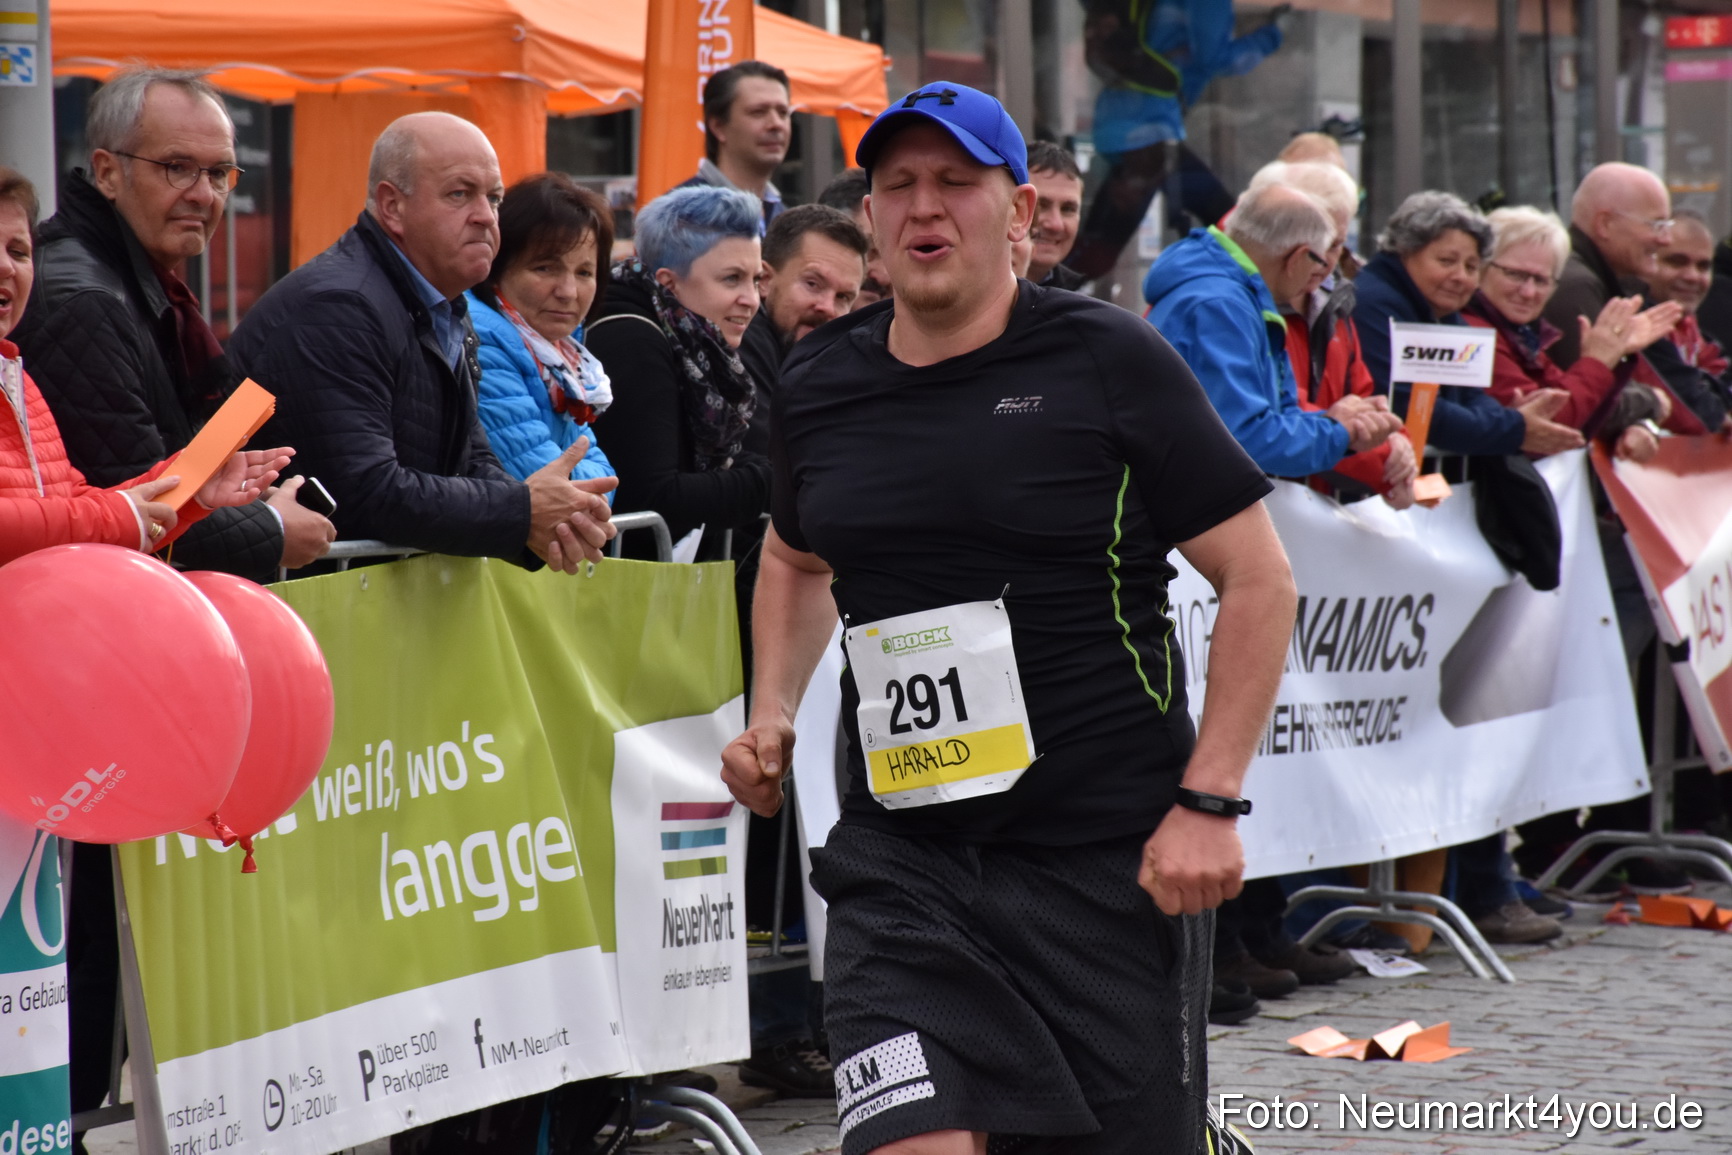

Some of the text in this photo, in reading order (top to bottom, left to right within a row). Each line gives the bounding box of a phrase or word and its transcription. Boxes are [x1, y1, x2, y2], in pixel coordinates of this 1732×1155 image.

[1402, 346, 1456, 362] swn
[892, 626, 952, 652] BOCK
[886, 667, 968, 735] 291
[886, 739, 970, 782] HARALD
[81, 769, 127, 813] energie
[312, 739, 401, 823] weiß,
[379, 816, 583, 922] langge
[19, 976, 68, 1012] Gebäud
[377, 1030, 437, 1066] über 500
[382, 1062, 449, 1096] Parkplätze
[219, 1094, 227, 1116] 1
[0, 1117, 72, 1155] dese
